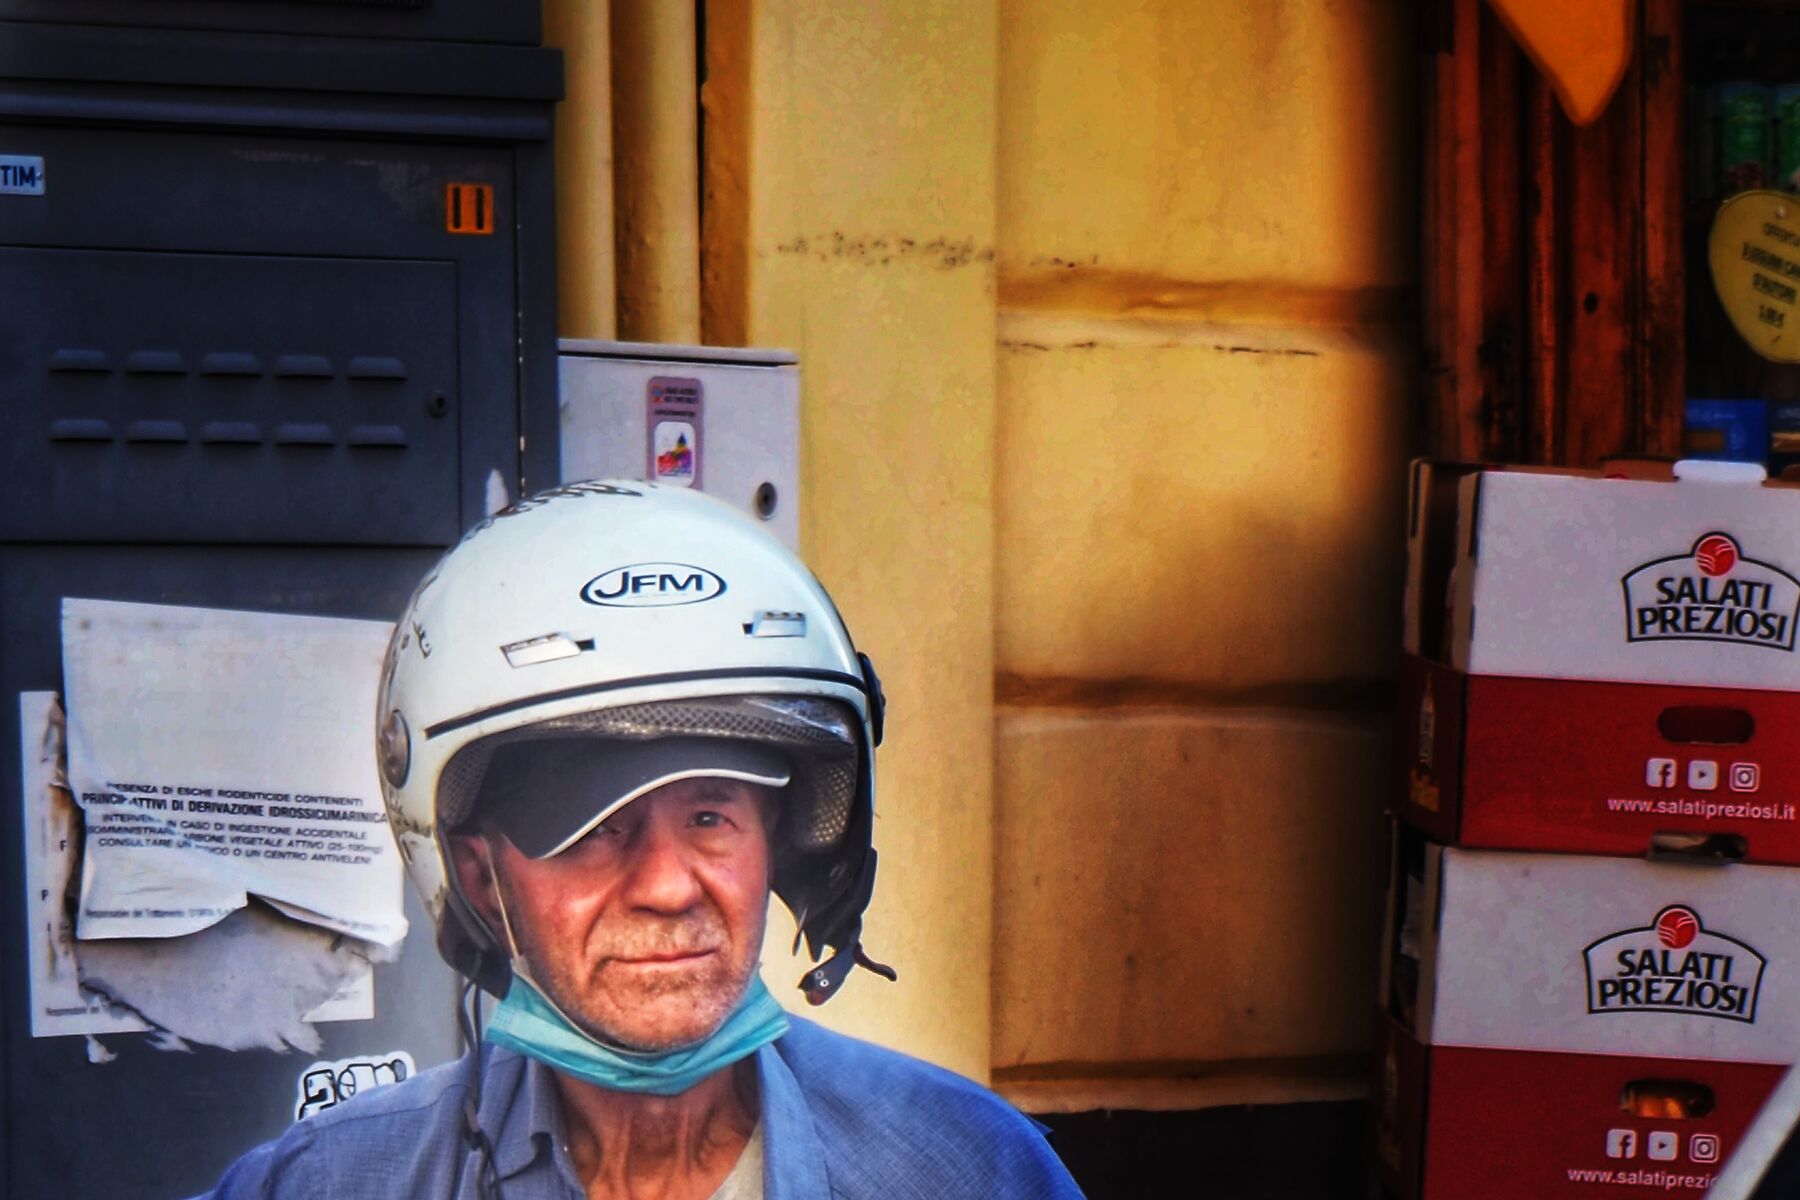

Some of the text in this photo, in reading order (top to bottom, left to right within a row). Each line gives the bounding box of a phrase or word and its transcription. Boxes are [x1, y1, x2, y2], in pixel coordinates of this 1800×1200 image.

[0, 165, 36, 187] TIM
[594, 571, 703, 599] JFM
[1656, 576, 1773, 610] SALATI
[1636, 606, 1787, 642] PREZIOSI
[162, 786, 174, 795] DI
[177, 787, 213, 797] ESCHE
[218, 789, 290, 802] RODENTICIDE
[295, 794, 364, 806] CONTENENTI
[172, 799, 184, 811] DI
[188, 801, 264, 816] DERIVAZIONE
[1607, 798, 1796, 820] www.salatipreziosi.it
[181, 821, 211, 831] CASO
[215, 822, 225, 831] DI
[229, 823, 292, 836] INGESTIONE
[295, 828, 368, 840] ACCIDENTALE
[230, 836, 283, 848] VEGETALE
[287, 839, 324, 850] ATTIVO
[233, 848, 242, 856] O
[245, 849, 260, 859] UN
[264, 850, 308, 861] CENTRO
[1616, 949, 1734, 982] SALATI
[1597, 979, 1750, 1014] PREZIOSI
